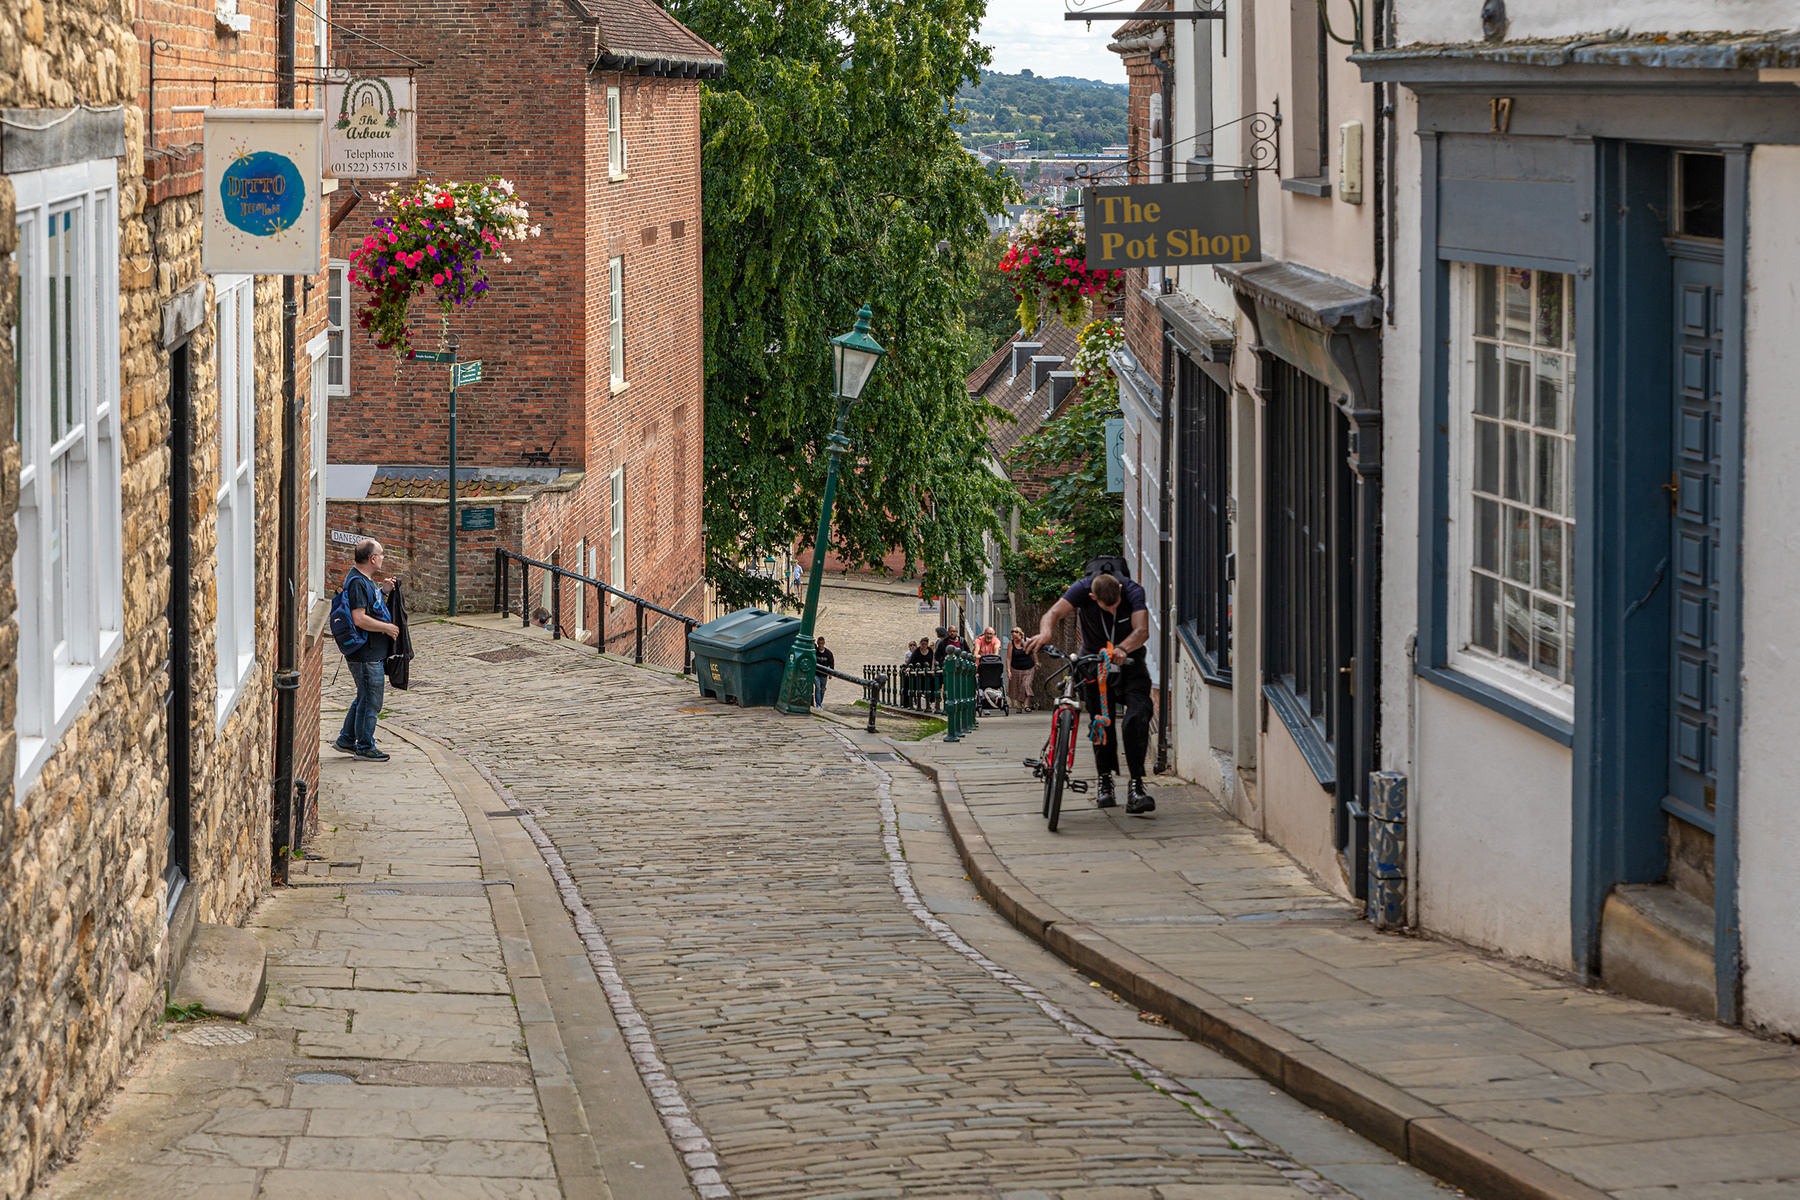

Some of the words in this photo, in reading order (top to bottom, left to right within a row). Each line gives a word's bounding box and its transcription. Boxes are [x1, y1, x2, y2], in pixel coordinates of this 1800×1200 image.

[359, 115, 378, 126] The
[1488, 98, 1512, 133] 17
[346, 127, 391, 140] Arbour
[344, 149, 395, 161] Telephone
[331, 162, 369, 174] (01522)
[372, 162, 408, 172] 537518
[227, 174, 286, 199] DITTO
[240, 202, 281, 216] DESIGN
[1096, 196, 1161, 224] The
[1099, 232, 1158, 261] Pot
[1166, 228, 1252, 262] Shop
[333, 531, 367, 544] DANESG
